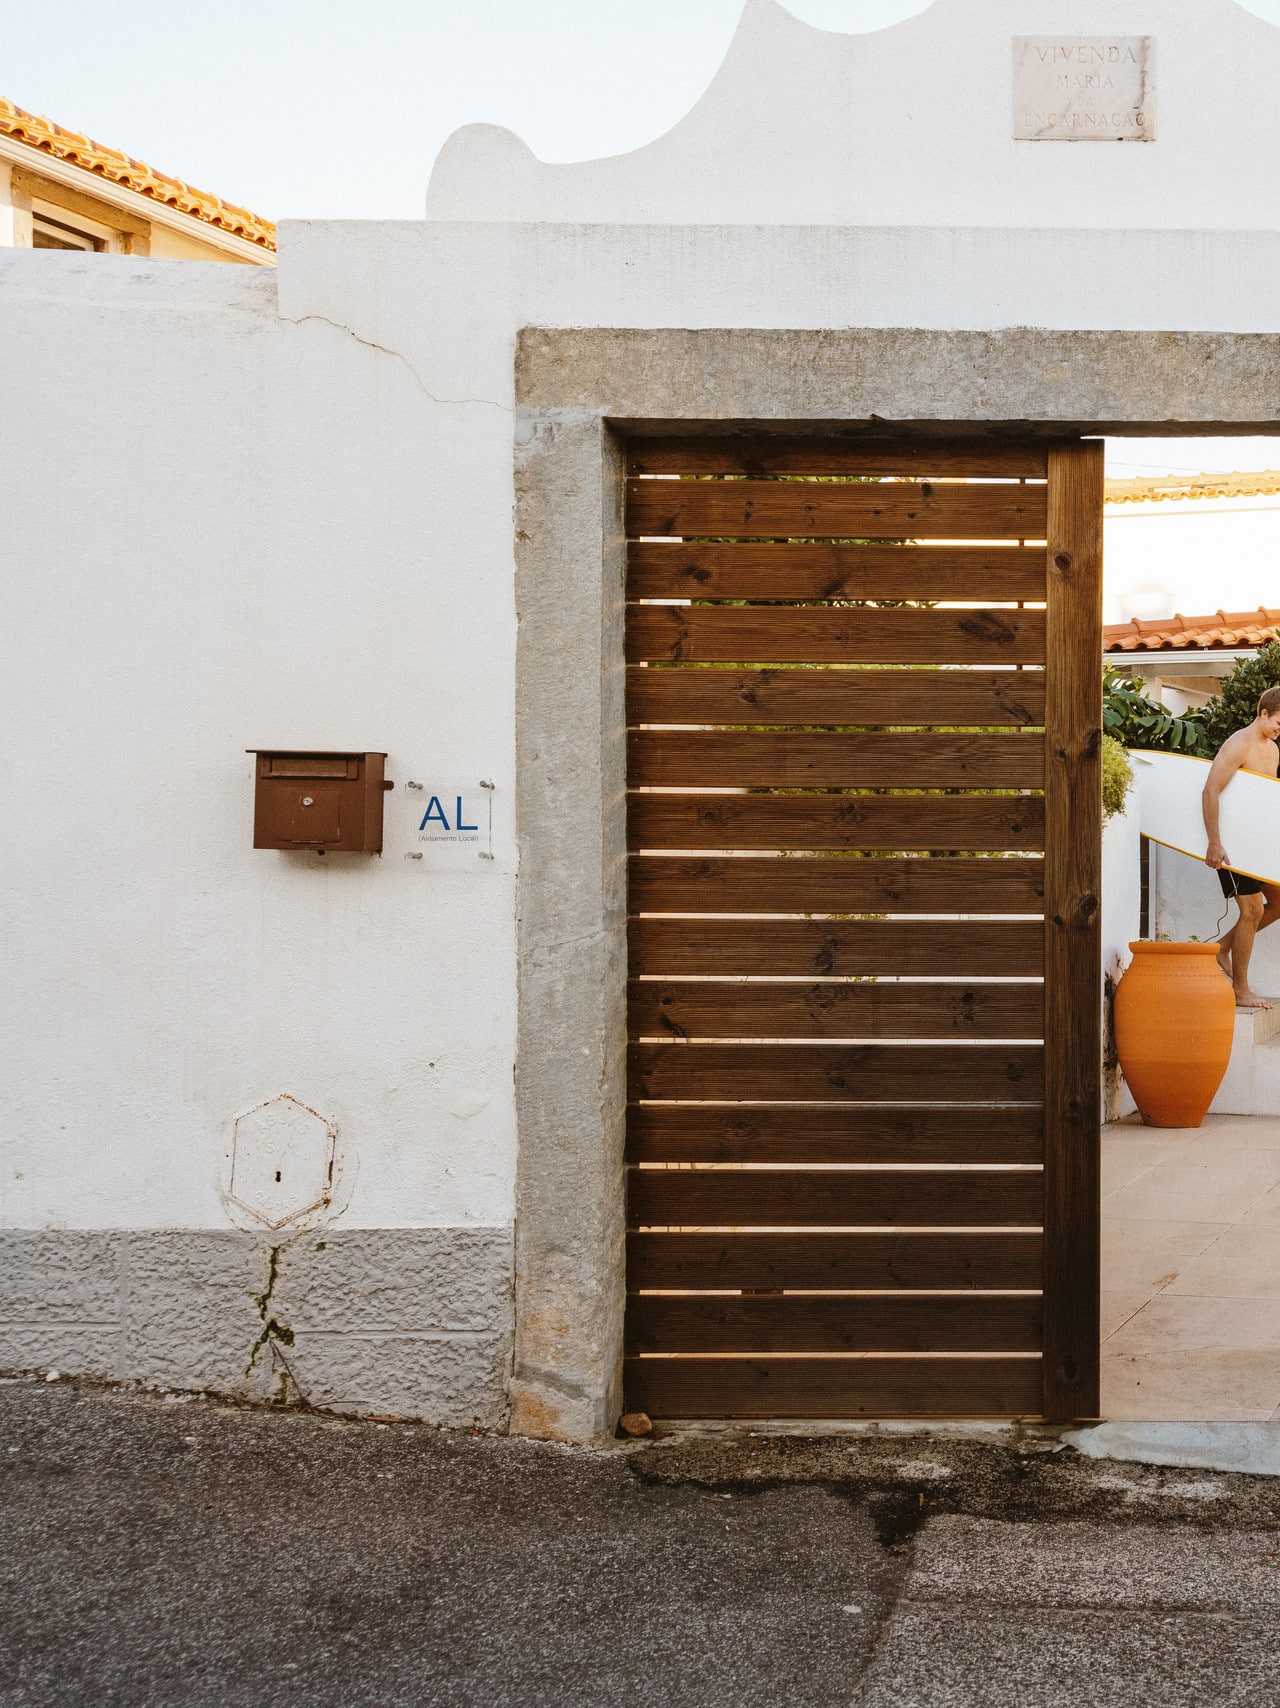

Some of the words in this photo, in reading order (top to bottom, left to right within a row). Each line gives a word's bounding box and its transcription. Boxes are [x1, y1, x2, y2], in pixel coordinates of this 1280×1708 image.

[1034, 46, 1138, 63] VIVENDA
[1056, 75, 1115, 89] MARIA
[419, 796, 479, 831] AL
